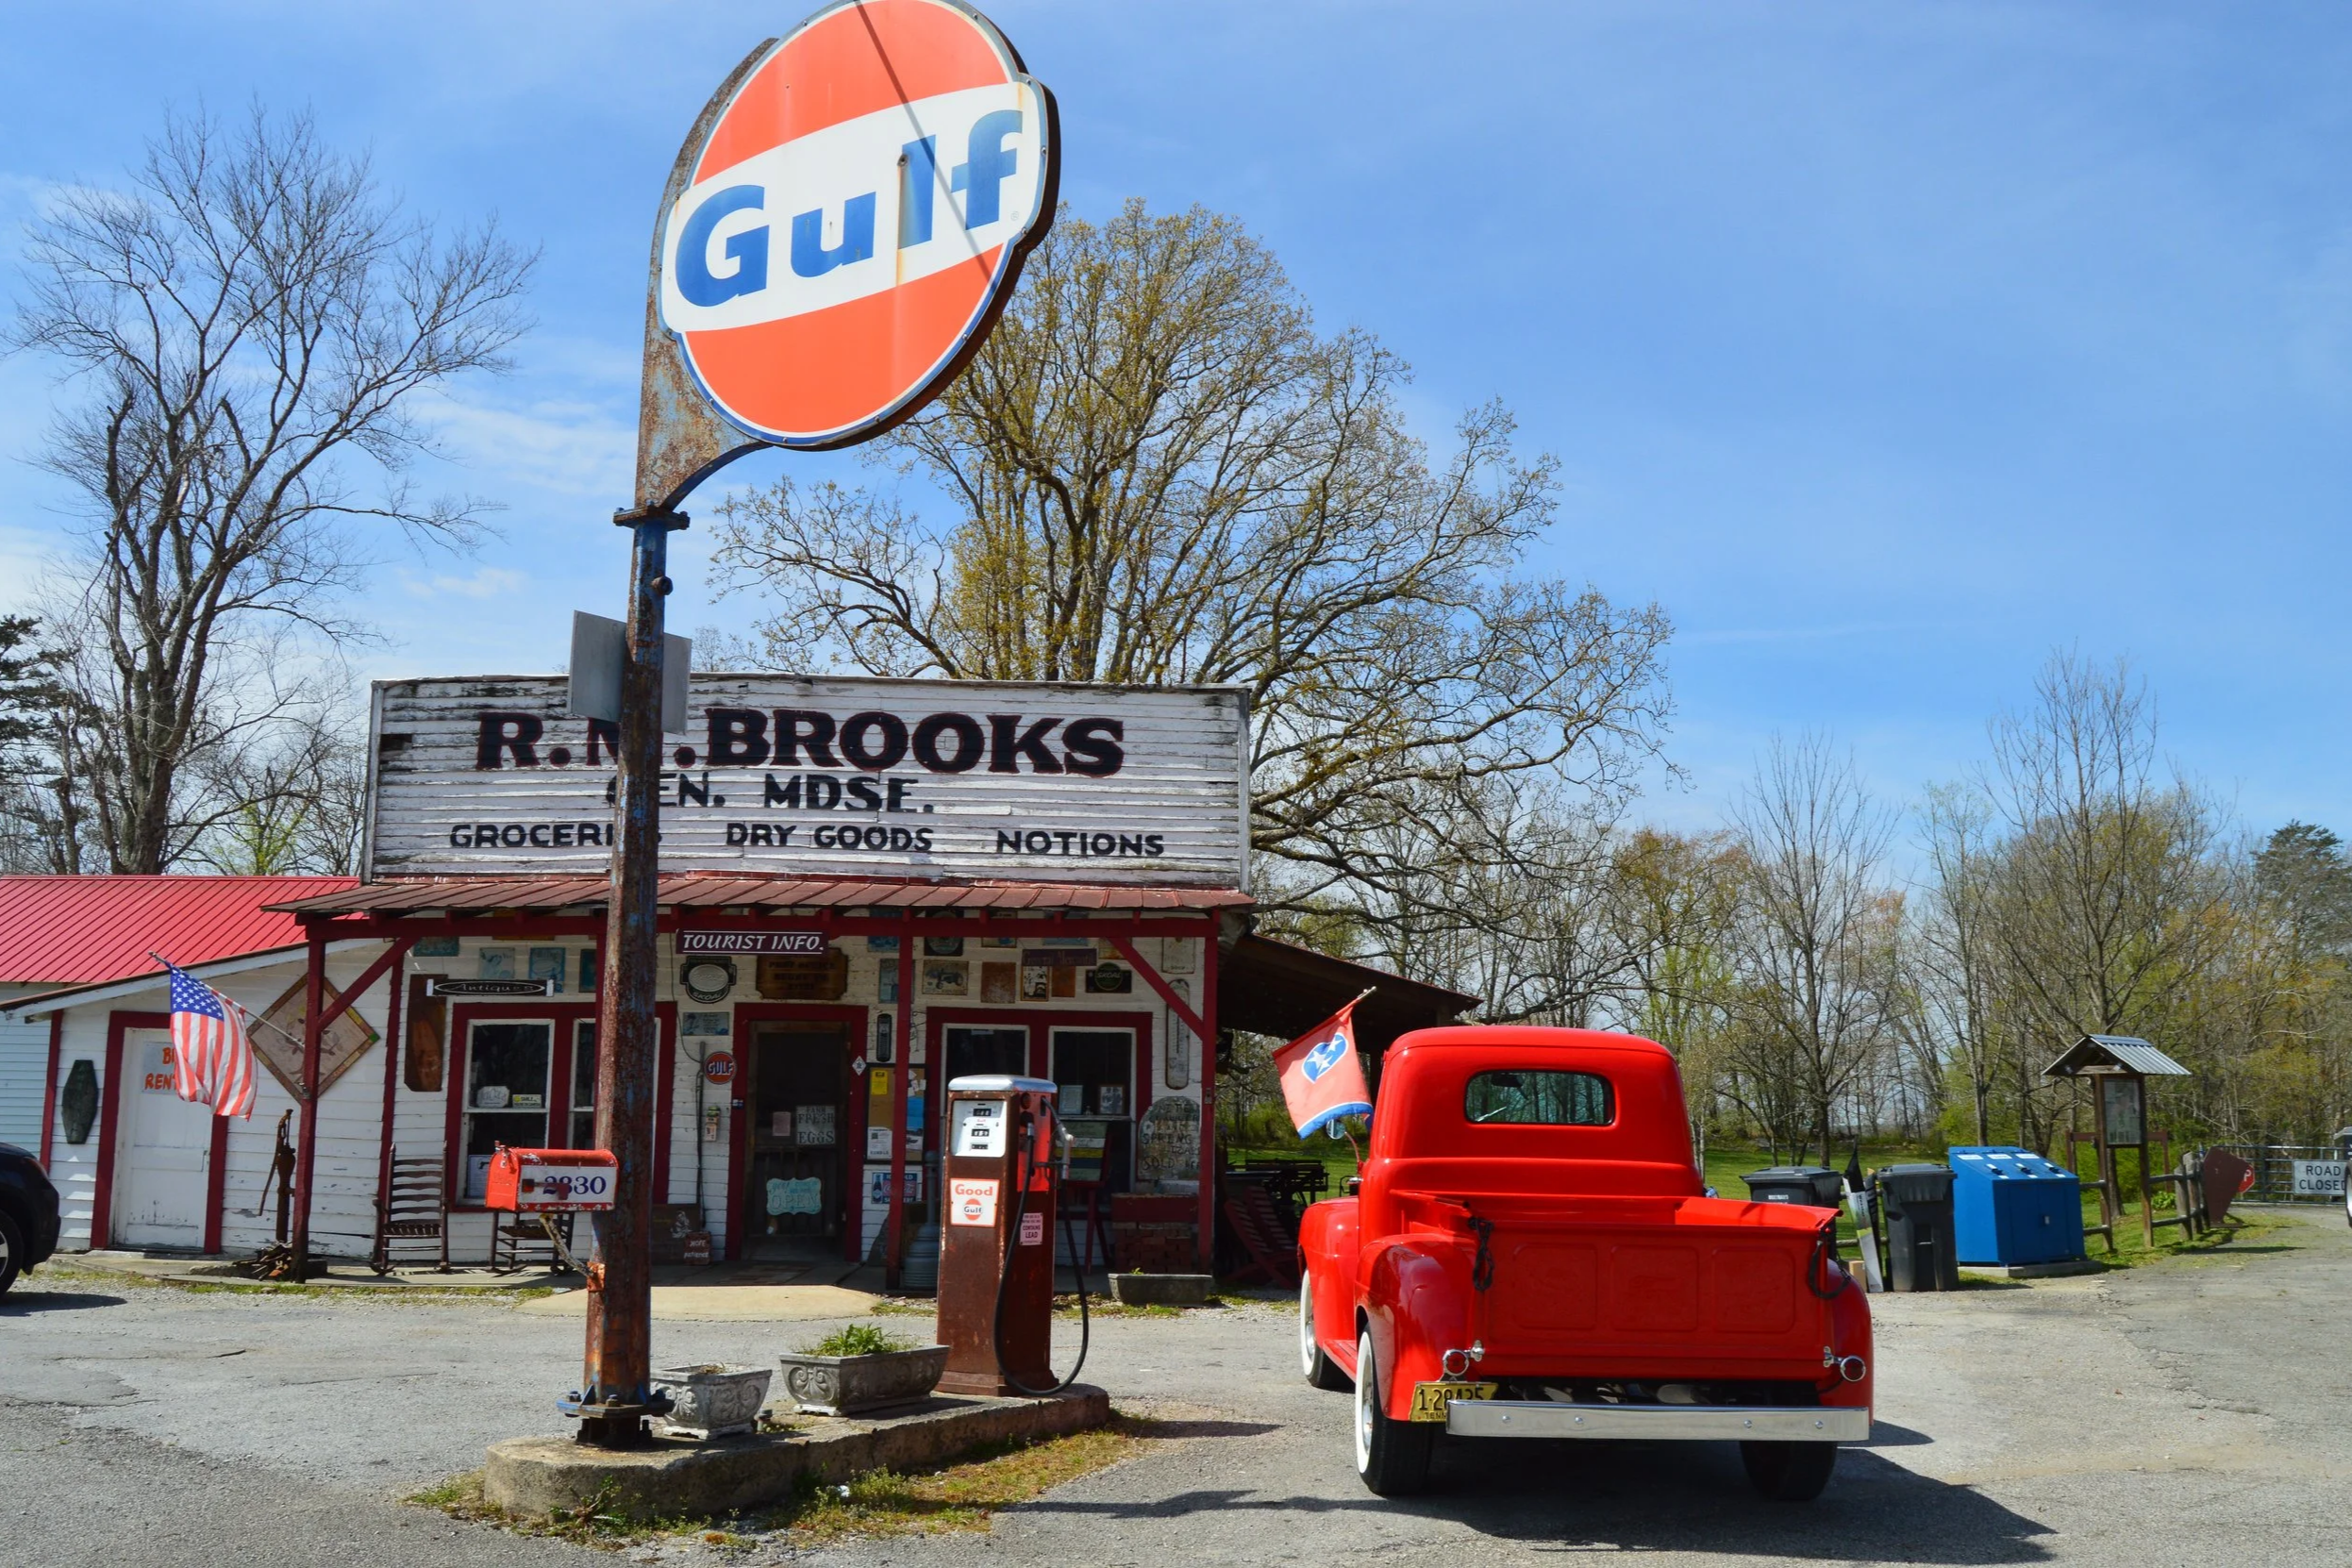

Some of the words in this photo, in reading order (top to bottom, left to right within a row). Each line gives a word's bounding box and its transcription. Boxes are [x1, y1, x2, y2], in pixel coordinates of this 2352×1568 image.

[676, 109, 1023, 307] Gulf
[765, 773, 935, 813] MDSE.
[450, 823, 661, 848] GROCERI
[726, 823, 797, 846] DRY
[814, 826, 934, 851] GOODS
[996, 830, 1164, 857] NOTIONS
[684, 934, 766, 949] TOURIST
[771, 935, 825, 951] INFO.
[707, 1060, 734, 1076] GULF
[798, 1113, 835, 1125] FRESH
[798, 1131, 835, 1144] EGGS
[2306, 1165, 2342, 1176] ROAD
[955, 1183, 993, 1196] Good
